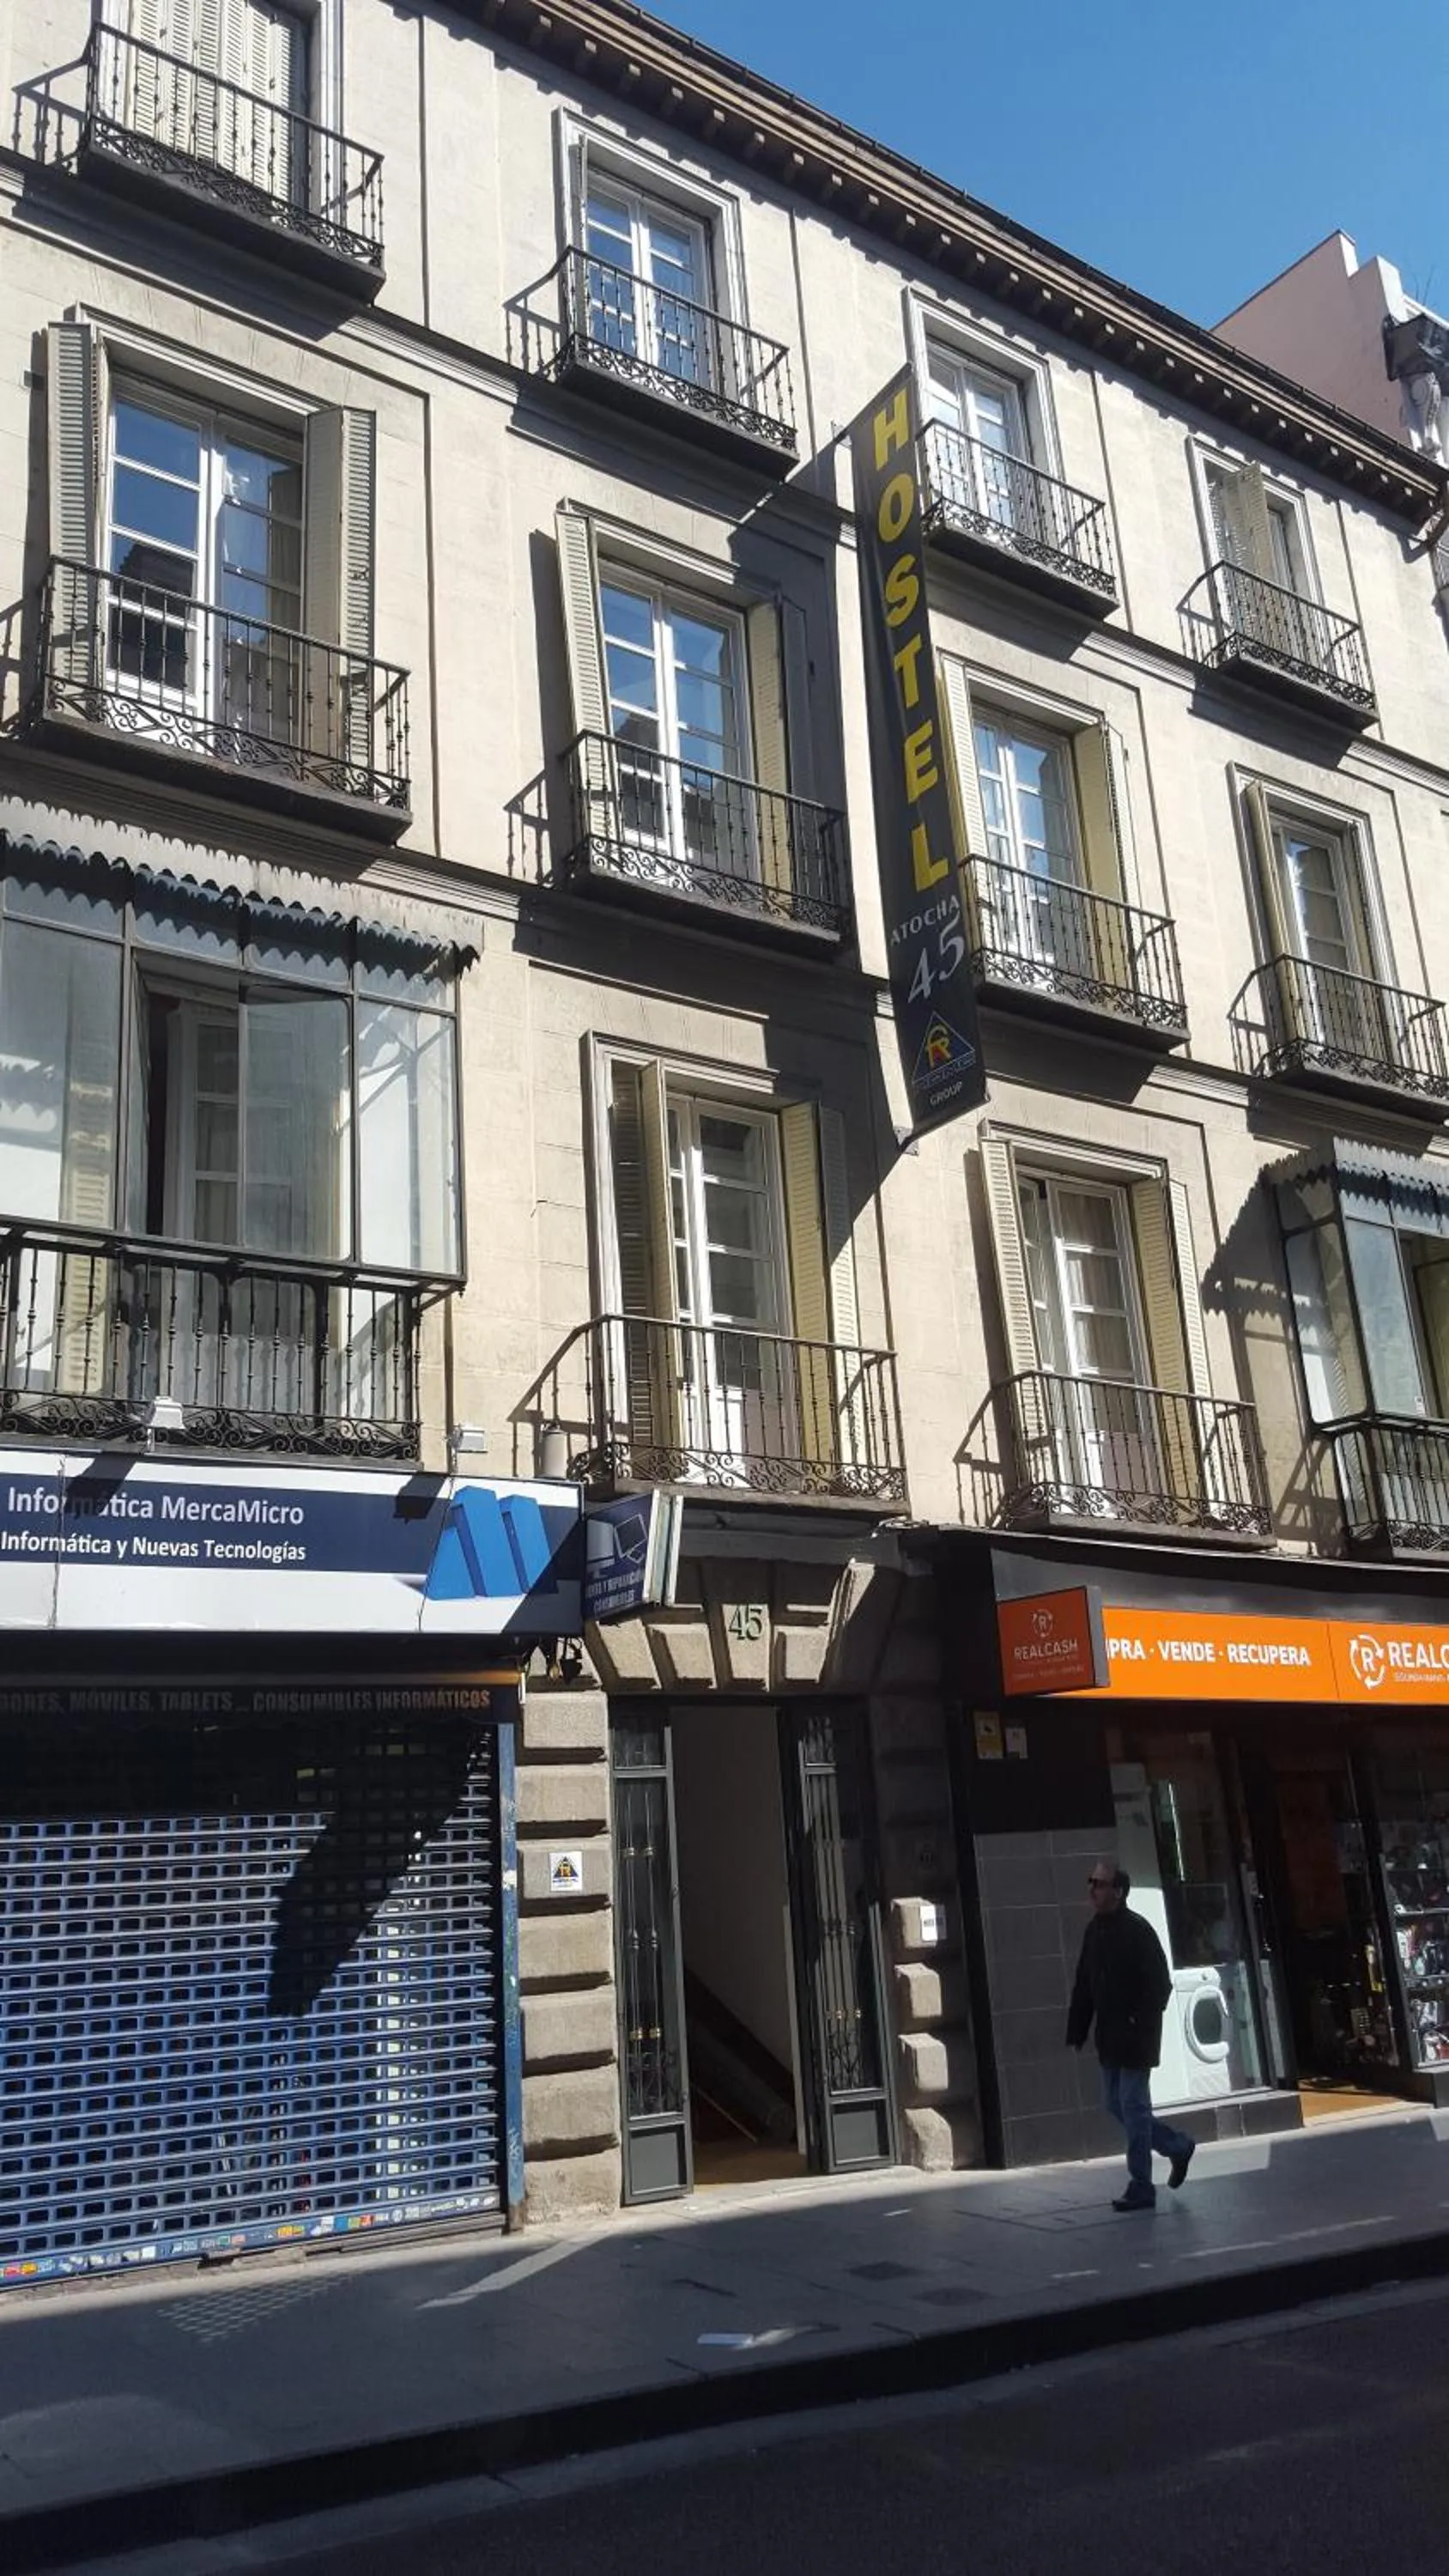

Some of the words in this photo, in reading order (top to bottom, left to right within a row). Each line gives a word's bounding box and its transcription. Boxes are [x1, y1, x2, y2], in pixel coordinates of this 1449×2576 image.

[874, 389, 948, 892] HOSTEL
[890, 894, 961, 945] ATOCHA
[907, 910, 965, 1003] 45
[929, 1081, 962, 1106] GROUP
[161, 1495, 304, 1525] MercaMicro
[1, 1531, 111, 1554] Informática
[117, 1540, 128, 1558] y
[133, 1536, 199, 1557] Nuevas
[203, 1539, 306, 1564] Tecnologías
[728, 1604, 762, 1641] 45
[1015, 1638, 1078, 1661] REALCASH
[1106, 1637, 1146, 1660] PRA
[1157, 1640, 1216, 1662] VENDE
[1227, 1643, 1311, 1666] RECUPERA
[375, 1687, 490, 1709] INFORMÁTICOS
